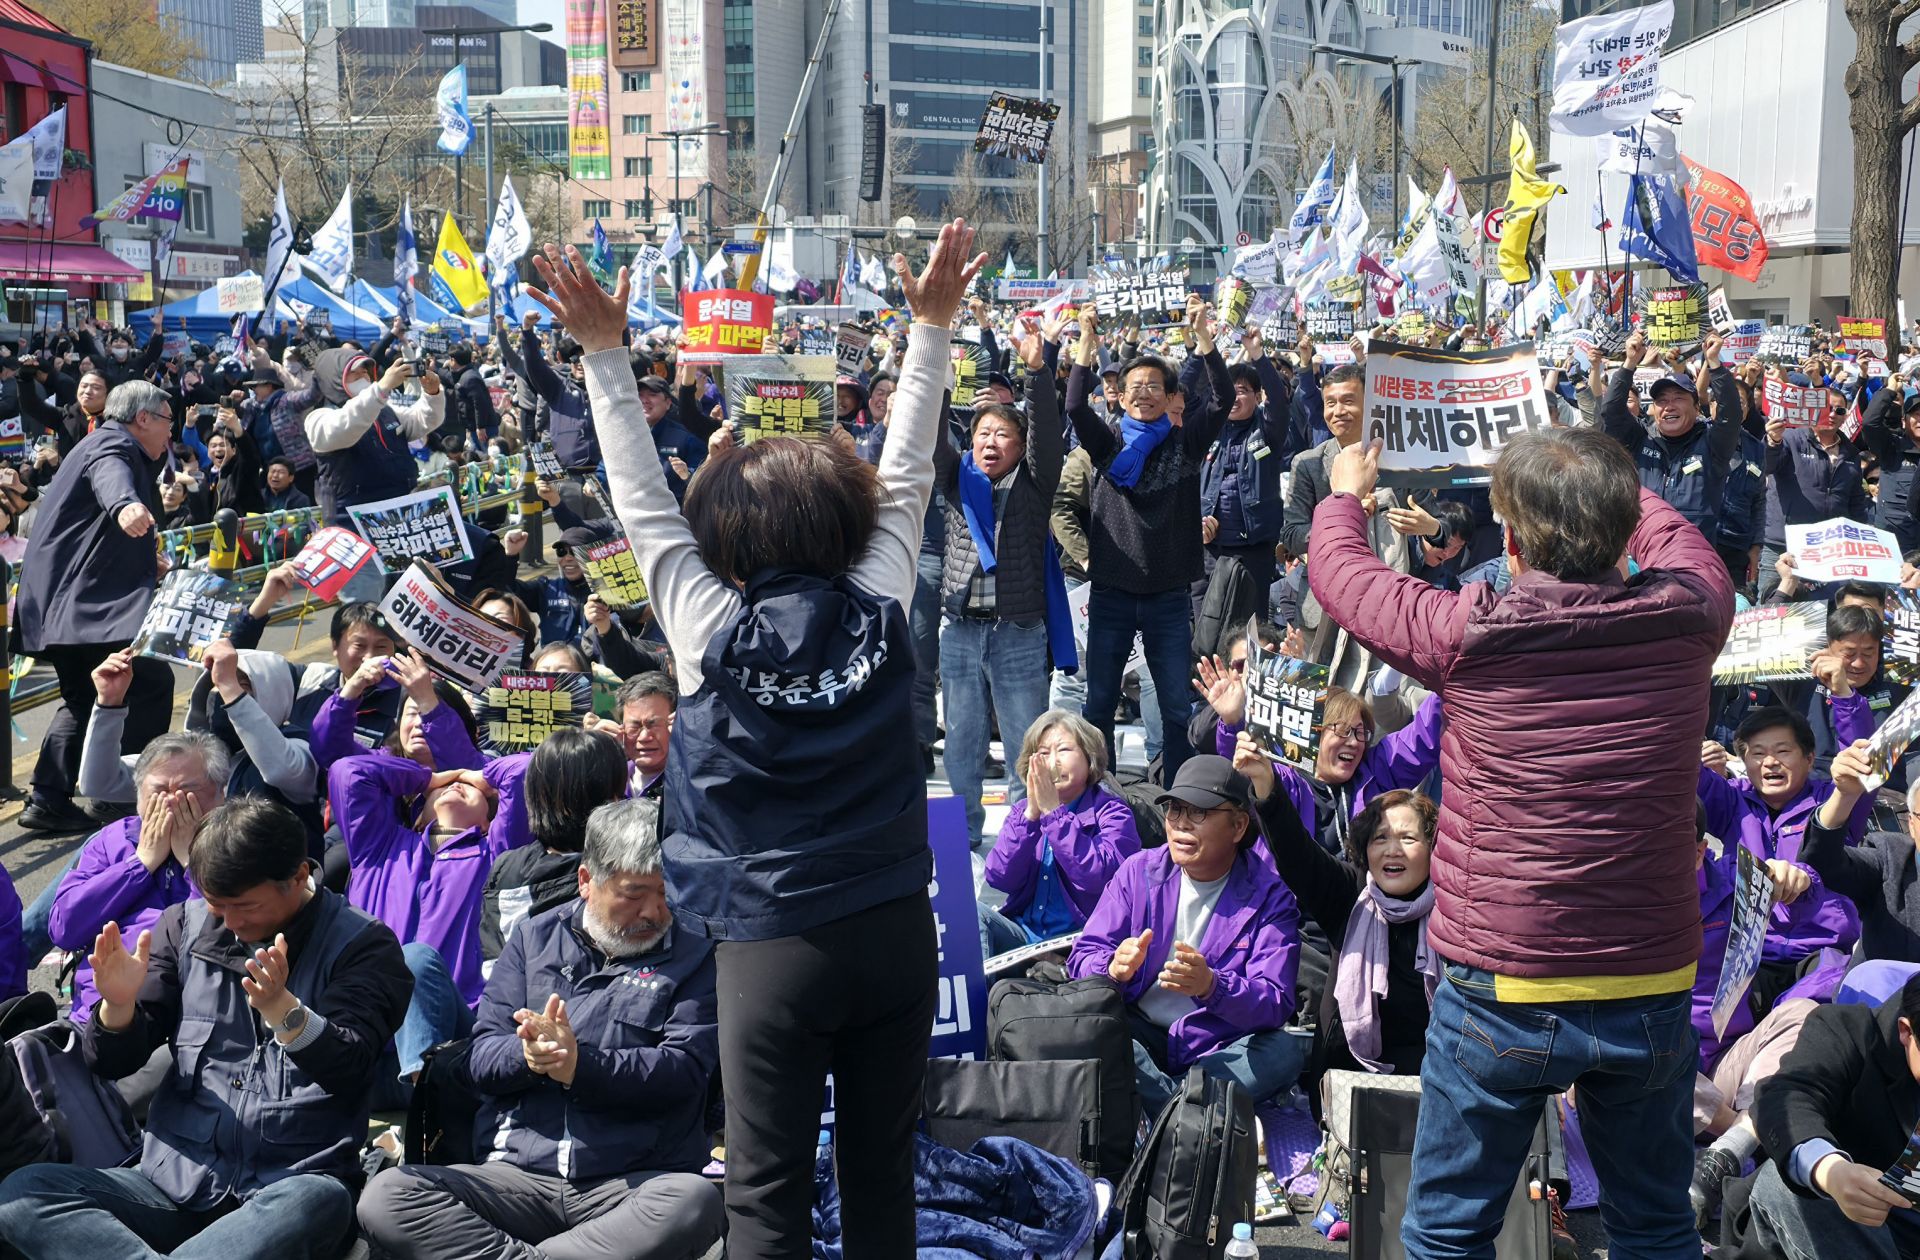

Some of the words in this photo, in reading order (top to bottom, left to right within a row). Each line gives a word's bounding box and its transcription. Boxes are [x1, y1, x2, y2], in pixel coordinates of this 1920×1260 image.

[431, 37, 474, 47] KORAN
[923, 115, 951, 123] DENTAL
[985, 106, 1049, 138] 즉각파면
[1147, 270, 1184, 286] 윤석열
[698, 299, 753, 322] 윤석열
[1096, 285, 1186, 317] 즉각파면
[687, 326, 714, 346] 즉각
[1734, 322, 1762, 334] 석열은
[1373, 374, 1436, 401] 내란동조
[745, 396, 819, 418] 윤석열을
[1369, 399, 1543, 453] 해체하라
[410, 513, 449, 534] 윤석열
[1805, 524, 1879, 545] 윤석열은
[374, 527, 456, 558] 즉각파면
[1800, 542, 1893, 563] 즉각파면!
[178, 589, 232, 620] 윤석열
[405, 578, 450, 624] 내란동조
[391, 592, 499, 677] 해체하라
[489, 688, 572, 711] 윤석열을
[1263, 676, 1317, 711] 윤석열
